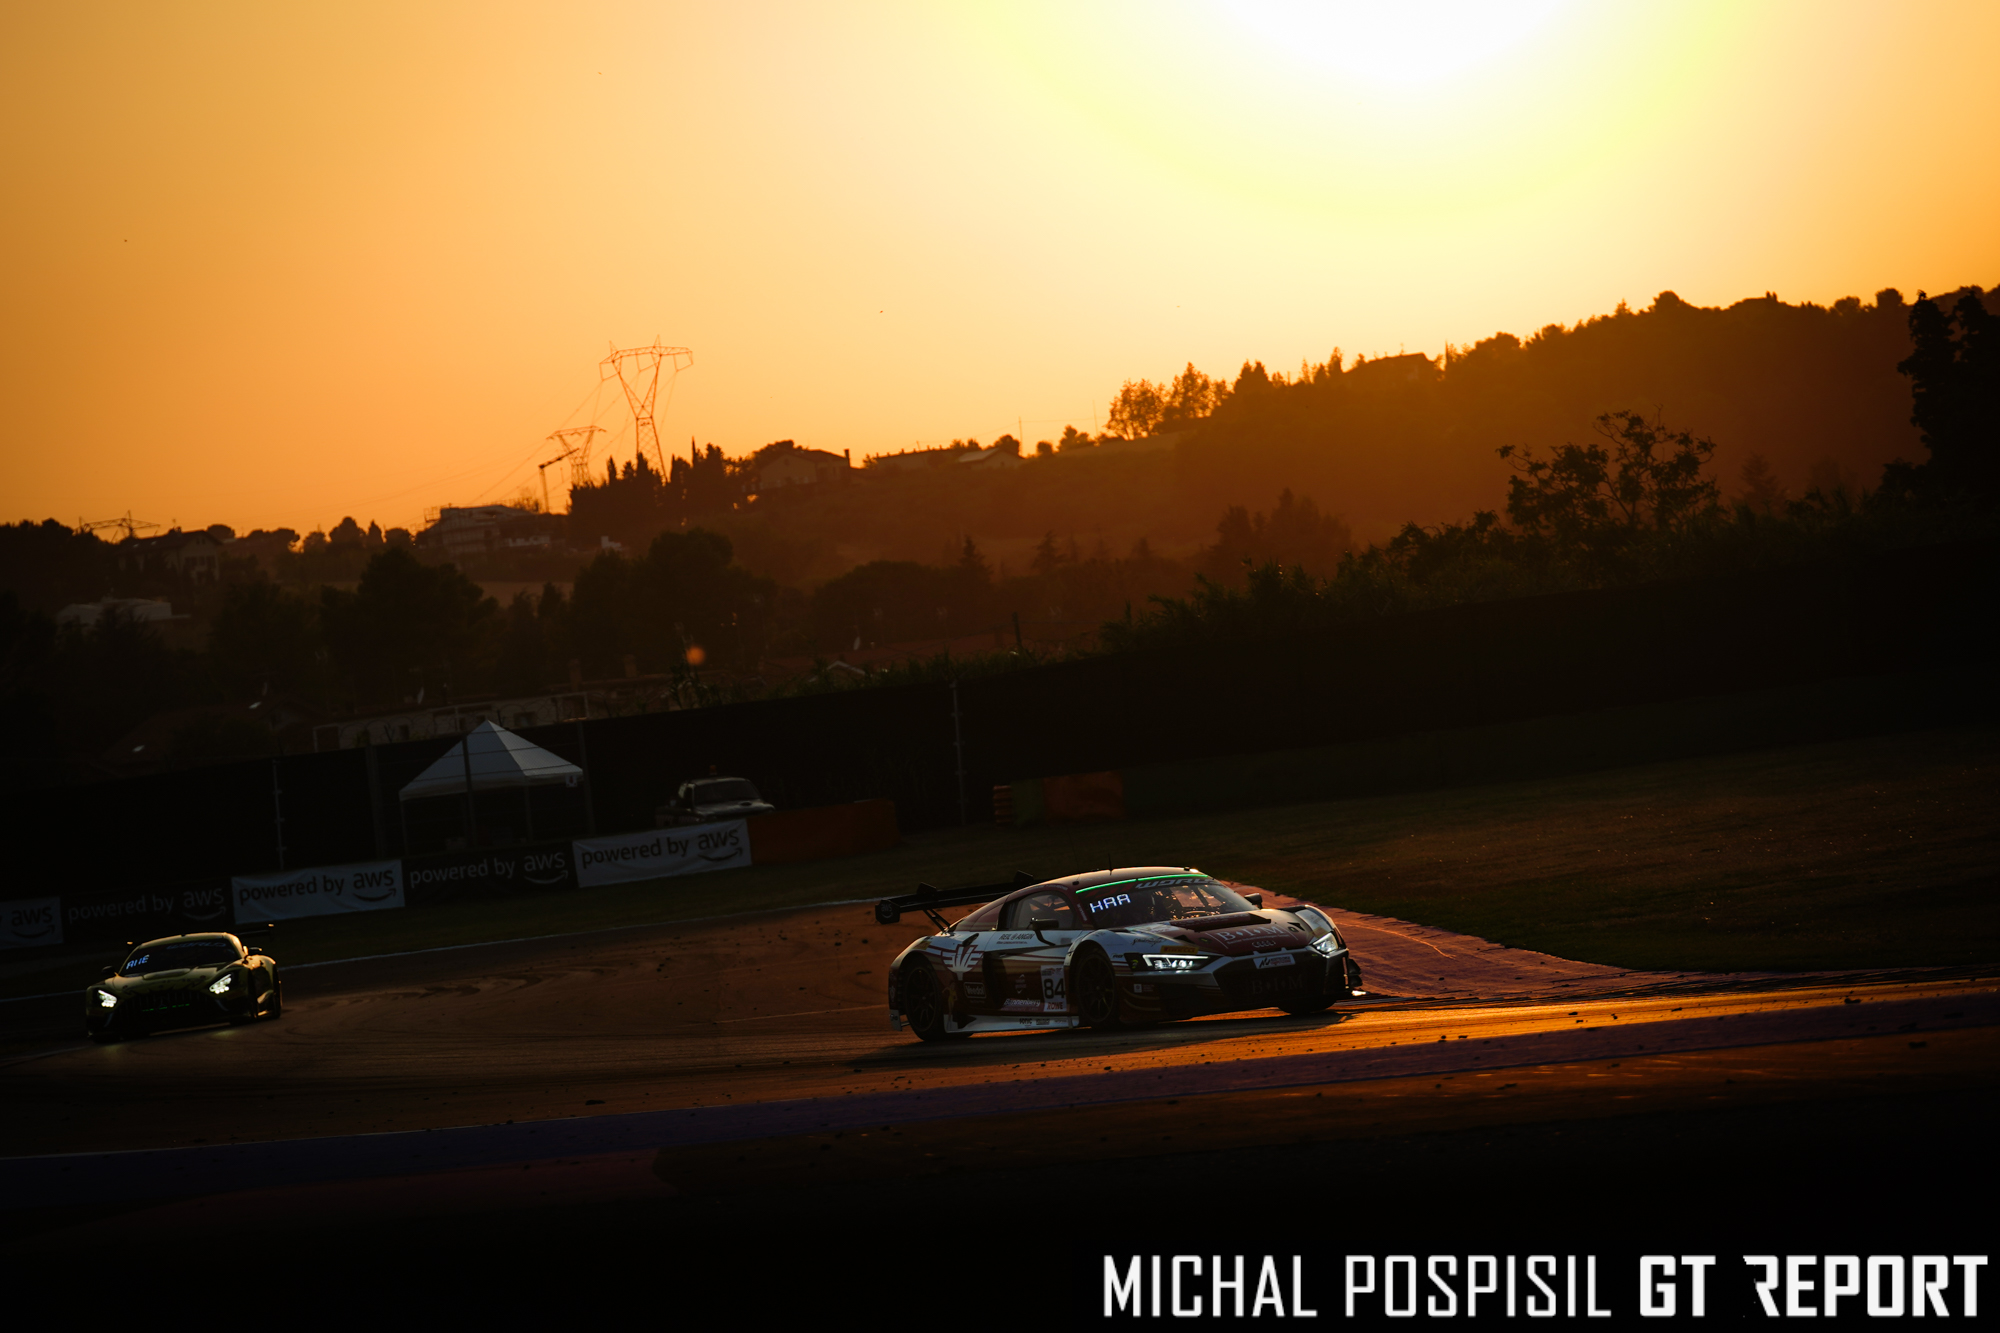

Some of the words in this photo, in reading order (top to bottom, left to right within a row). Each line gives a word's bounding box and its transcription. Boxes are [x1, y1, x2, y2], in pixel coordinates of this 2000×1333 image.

[581, 838, 661, 869] powered
[667, 836, 689, 857] by
[697, 829, 740, 851] aws
[409, 858, 488, 889] powered
[493, 857, 516, 879] by
[523, 852, 566, 872] aws
[239, 876, 317, 905] powered
[323, 875, 344, 896] by
[353, 870, 394, 889] aws
[12, 907, 53, 927] aws
[68, 895, 146, 924] powered
[152, 893, 174, 914] by
[183, 887, 224, 908] aws
[1089, 893, 1131, 913] HAA
[1044, 978, 1066, 999] 84
[1047, 1002, 1063, 1010] ROWE
